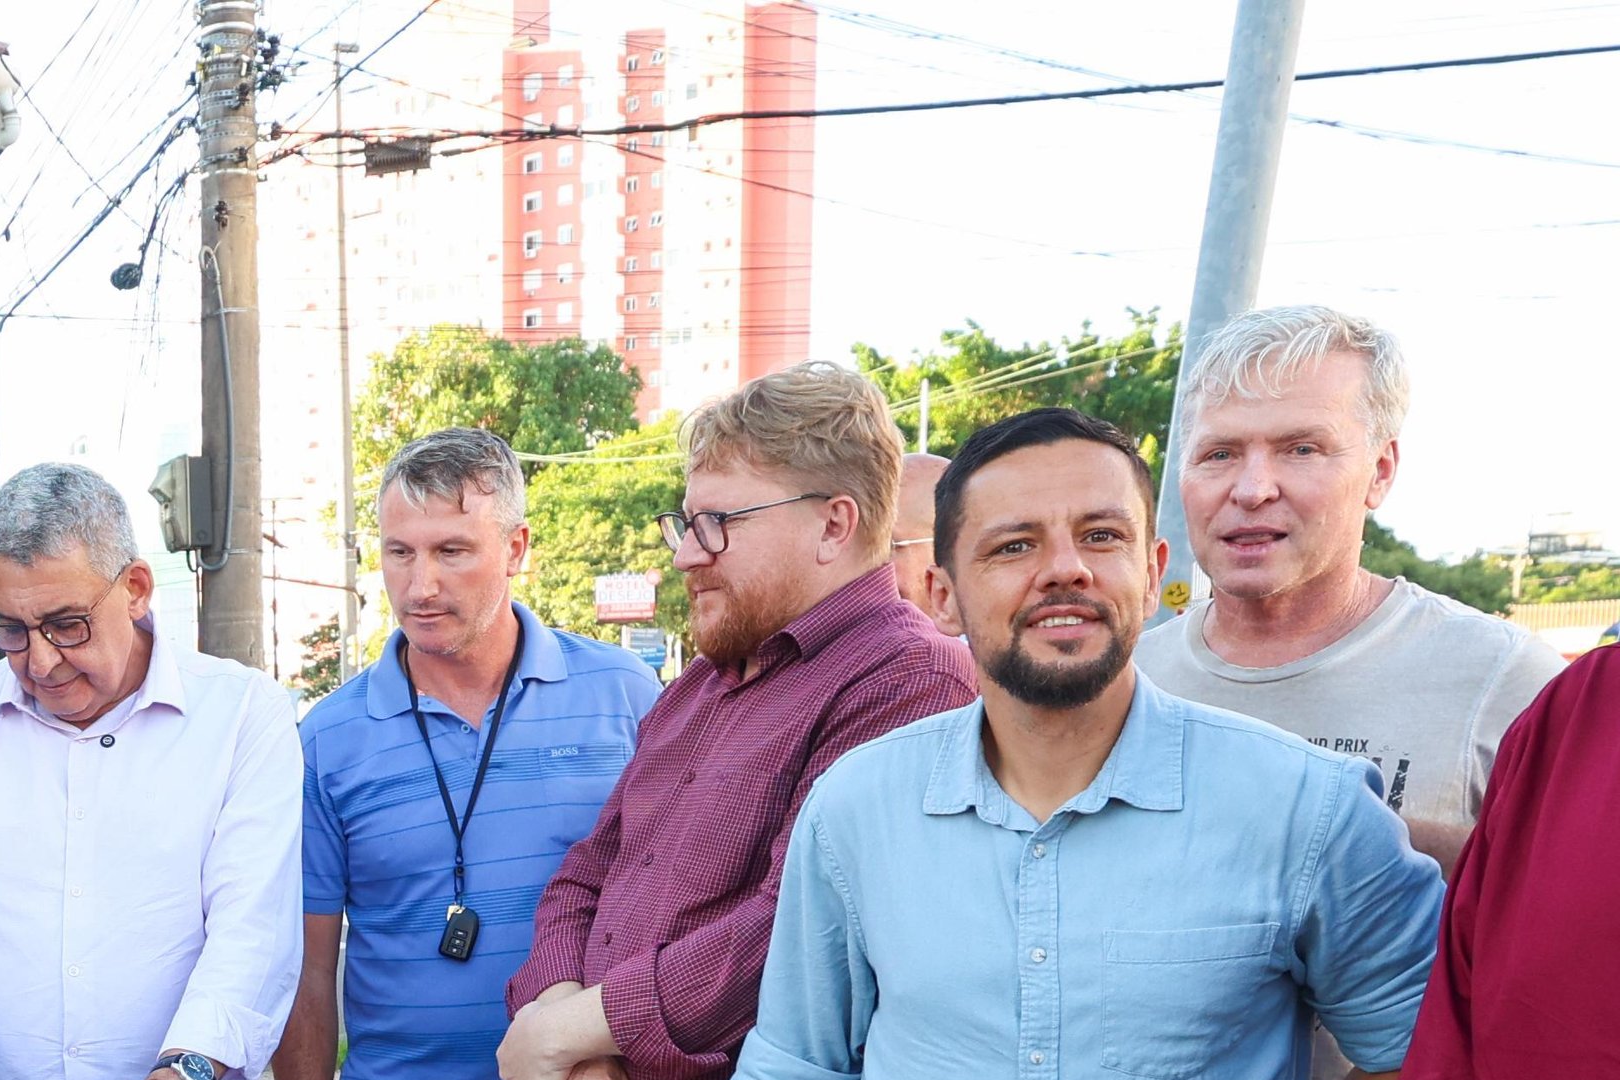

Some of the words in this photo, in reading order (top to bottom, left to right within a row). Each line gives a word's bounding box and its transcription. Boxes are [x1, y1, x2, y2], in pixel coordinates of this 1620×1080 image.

[605, 581, 647, 590] MOTEL
[598, 590, 653, 601] DESEJO
[1334, 737, 1370, 753] PRIX
[550, 746, 579, 757] BOSS
